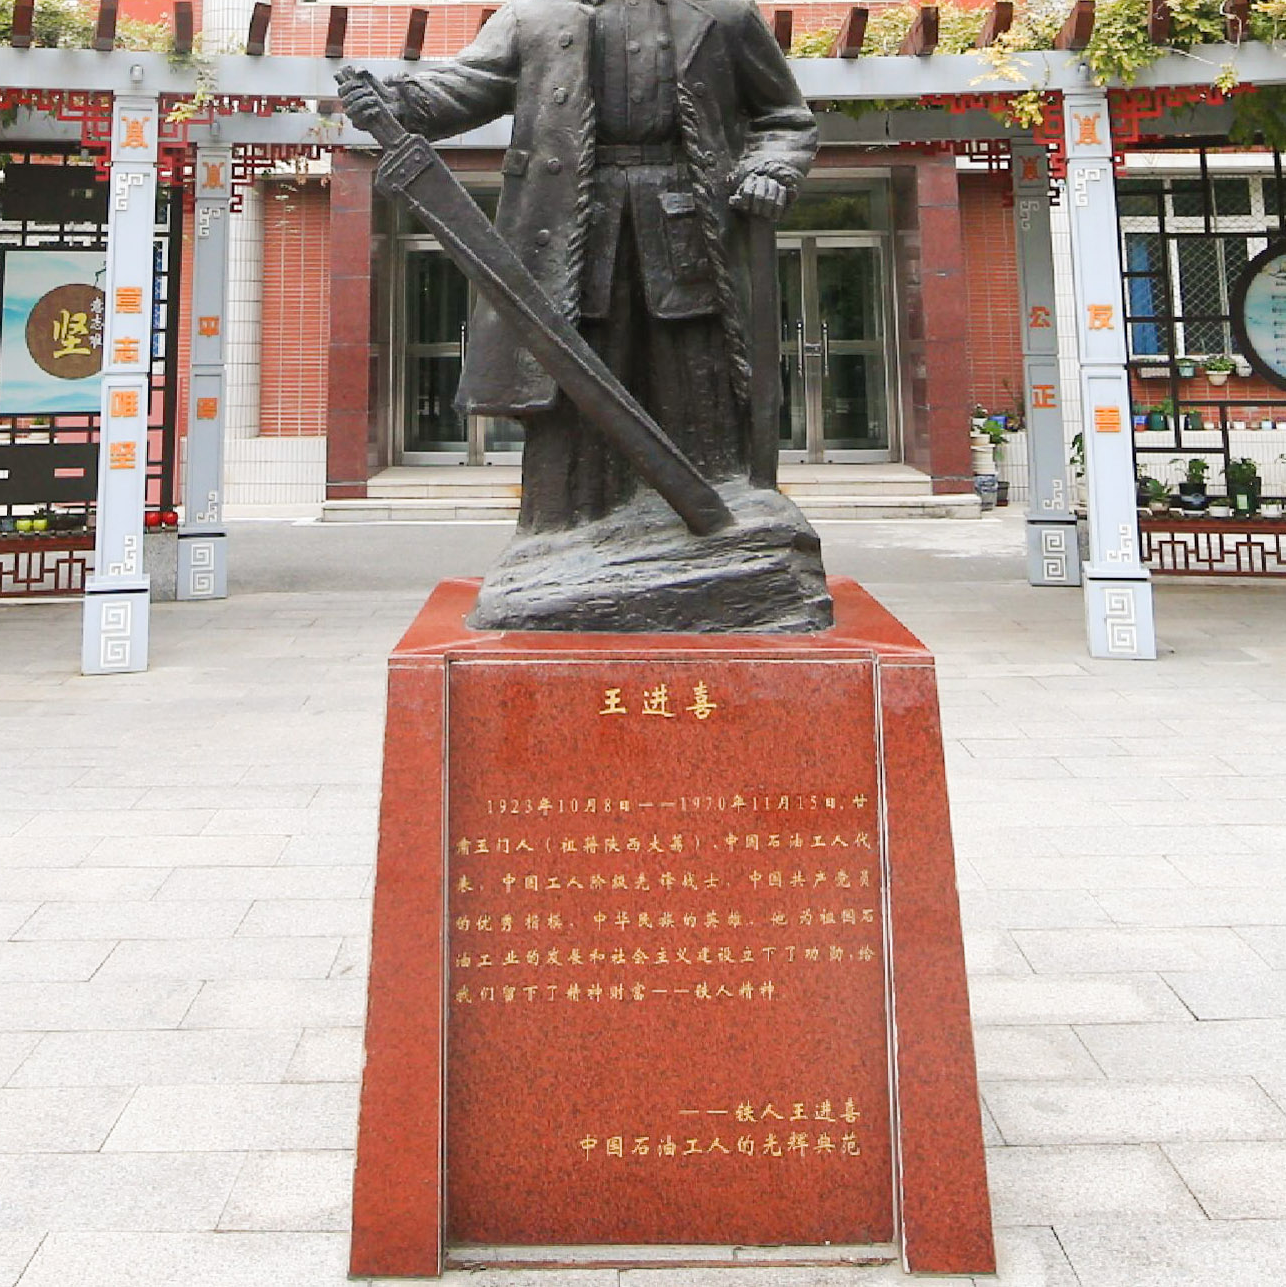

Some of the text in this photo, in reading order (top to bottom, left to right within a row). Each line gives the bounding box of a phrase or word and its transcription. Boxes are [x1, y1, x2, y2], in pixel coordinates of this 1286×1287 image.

[53, 308, 92, 359] 坚
[1029, 305, 1058, 410] 公正
[1086, 303, 1122, 433] 友善
[109, 286, 143, 470] 意志唯坚
[599, 680, 717, 720] 王进喜
[579, 1132, 861, 1162] 中国石油工人的光辉典范
